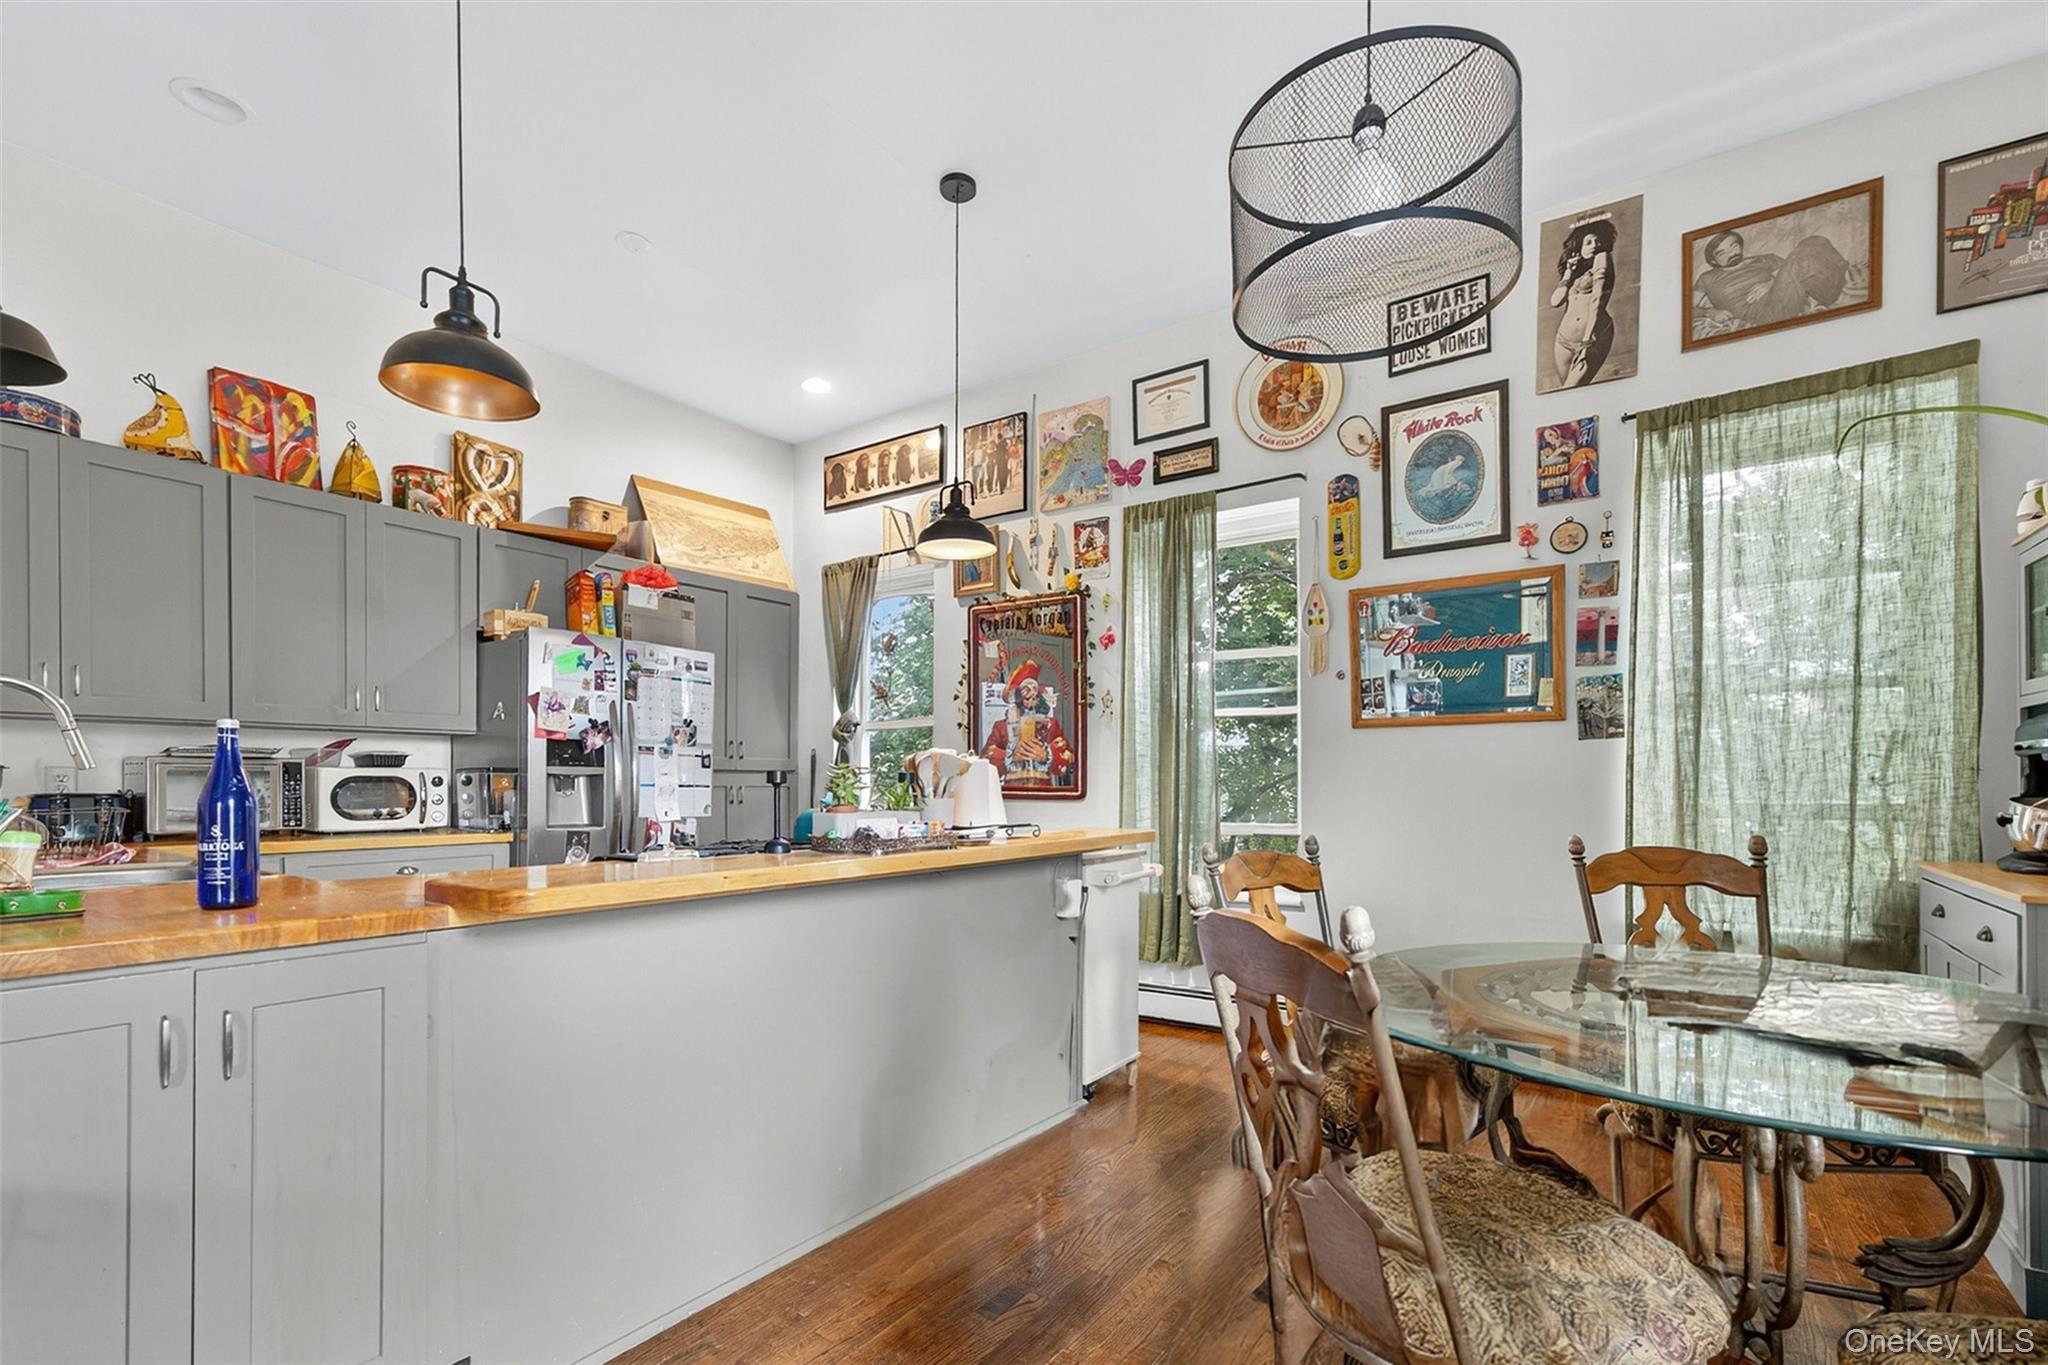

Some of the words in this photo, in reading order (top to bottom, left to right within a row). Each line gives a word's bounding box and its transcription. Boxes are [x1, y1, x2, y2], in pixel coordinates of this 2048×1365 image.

[1397, 282, 1480, 322] BEWARE
[1438, 326, 1486, 356] WOMEN
[1402, 416, 1444, 443] White
[1444, 405, 1484, 428] Rock
[1383, 624, 1531, 657] Budweiser
